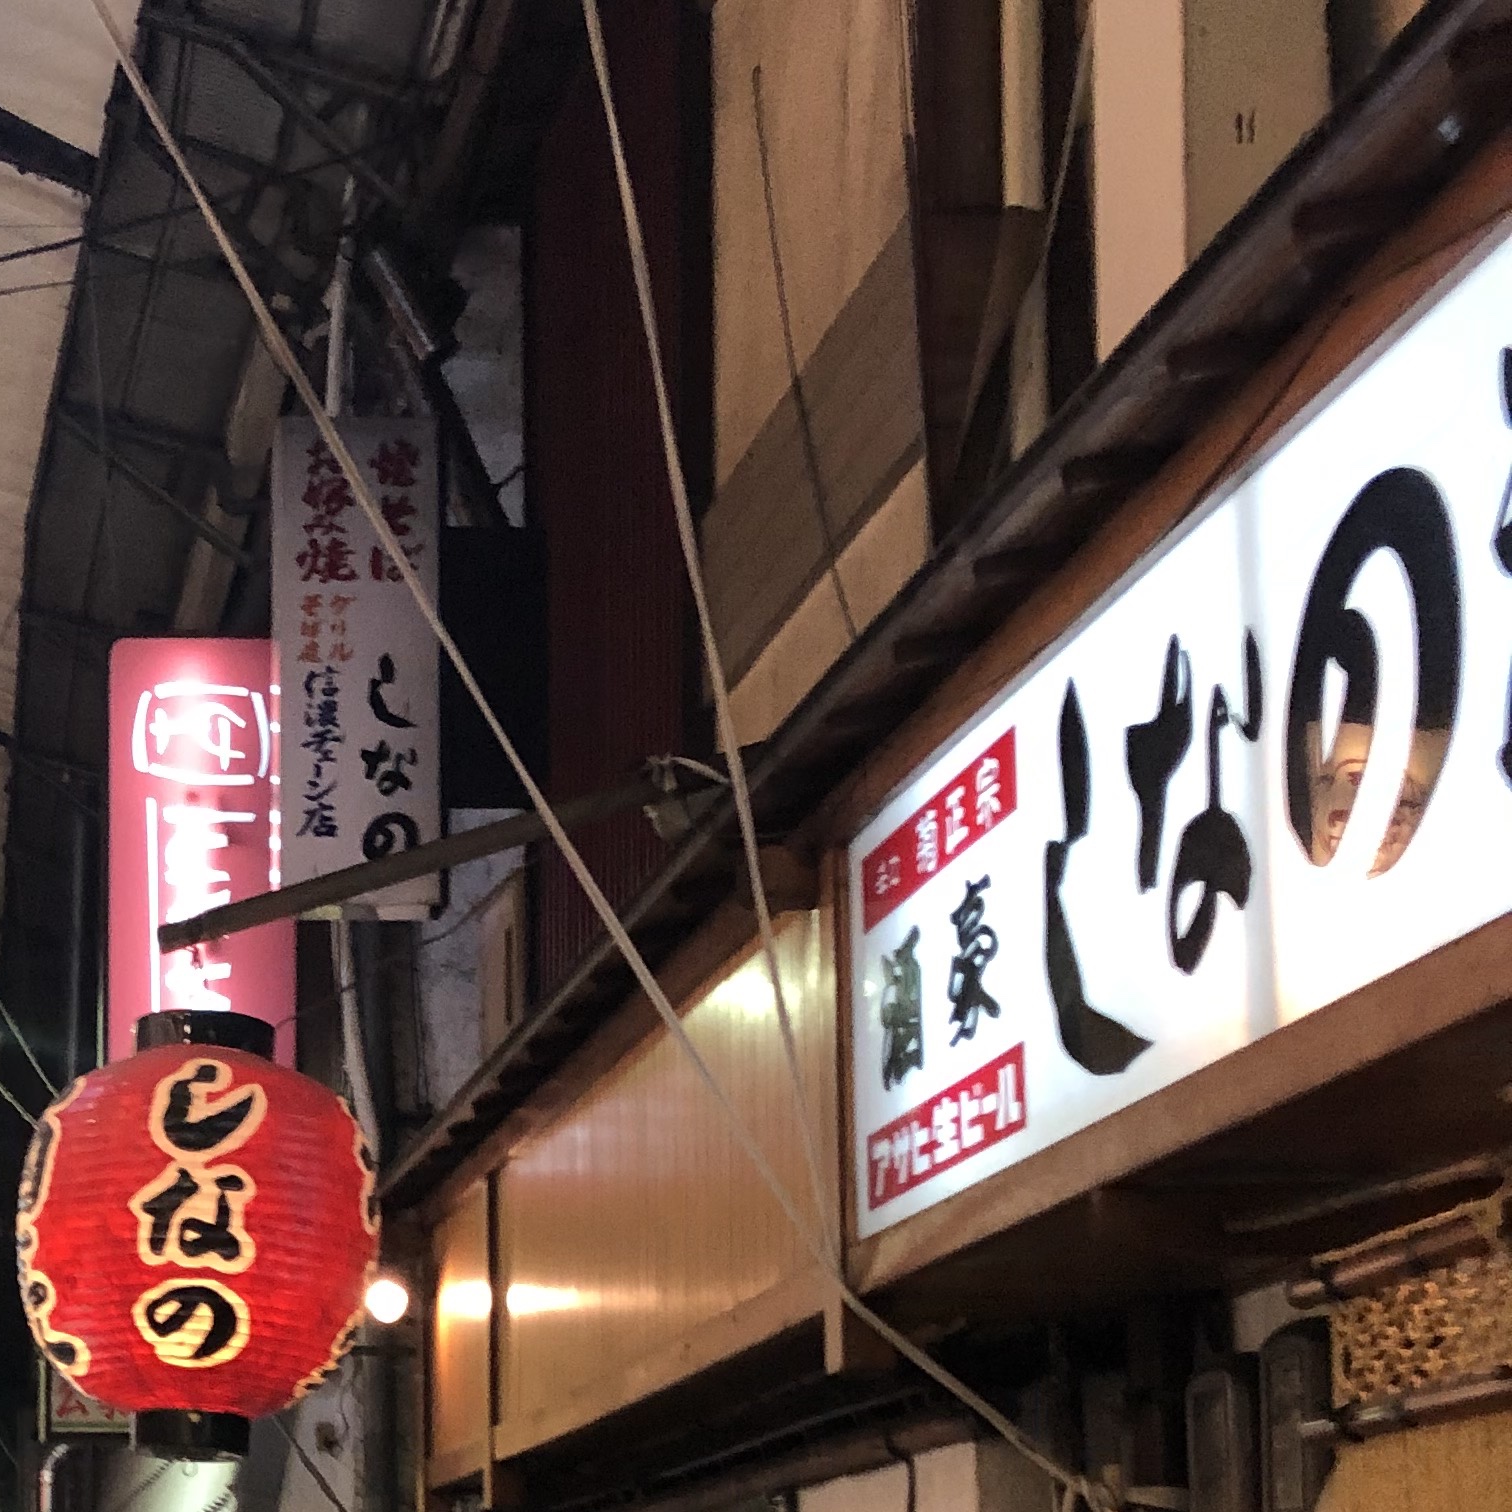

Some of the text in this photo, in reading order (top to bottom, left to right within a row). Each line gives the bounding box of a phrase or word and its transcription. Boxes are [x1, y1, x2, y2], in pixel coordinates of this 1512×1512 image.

[360, 653, 422, 859] しなの
[1045, 345, 1512, 1075] しなの
[141, 1063, 254, 1360] しなの
[870, 1063, 1023, 1198] アサヒ生ビール
